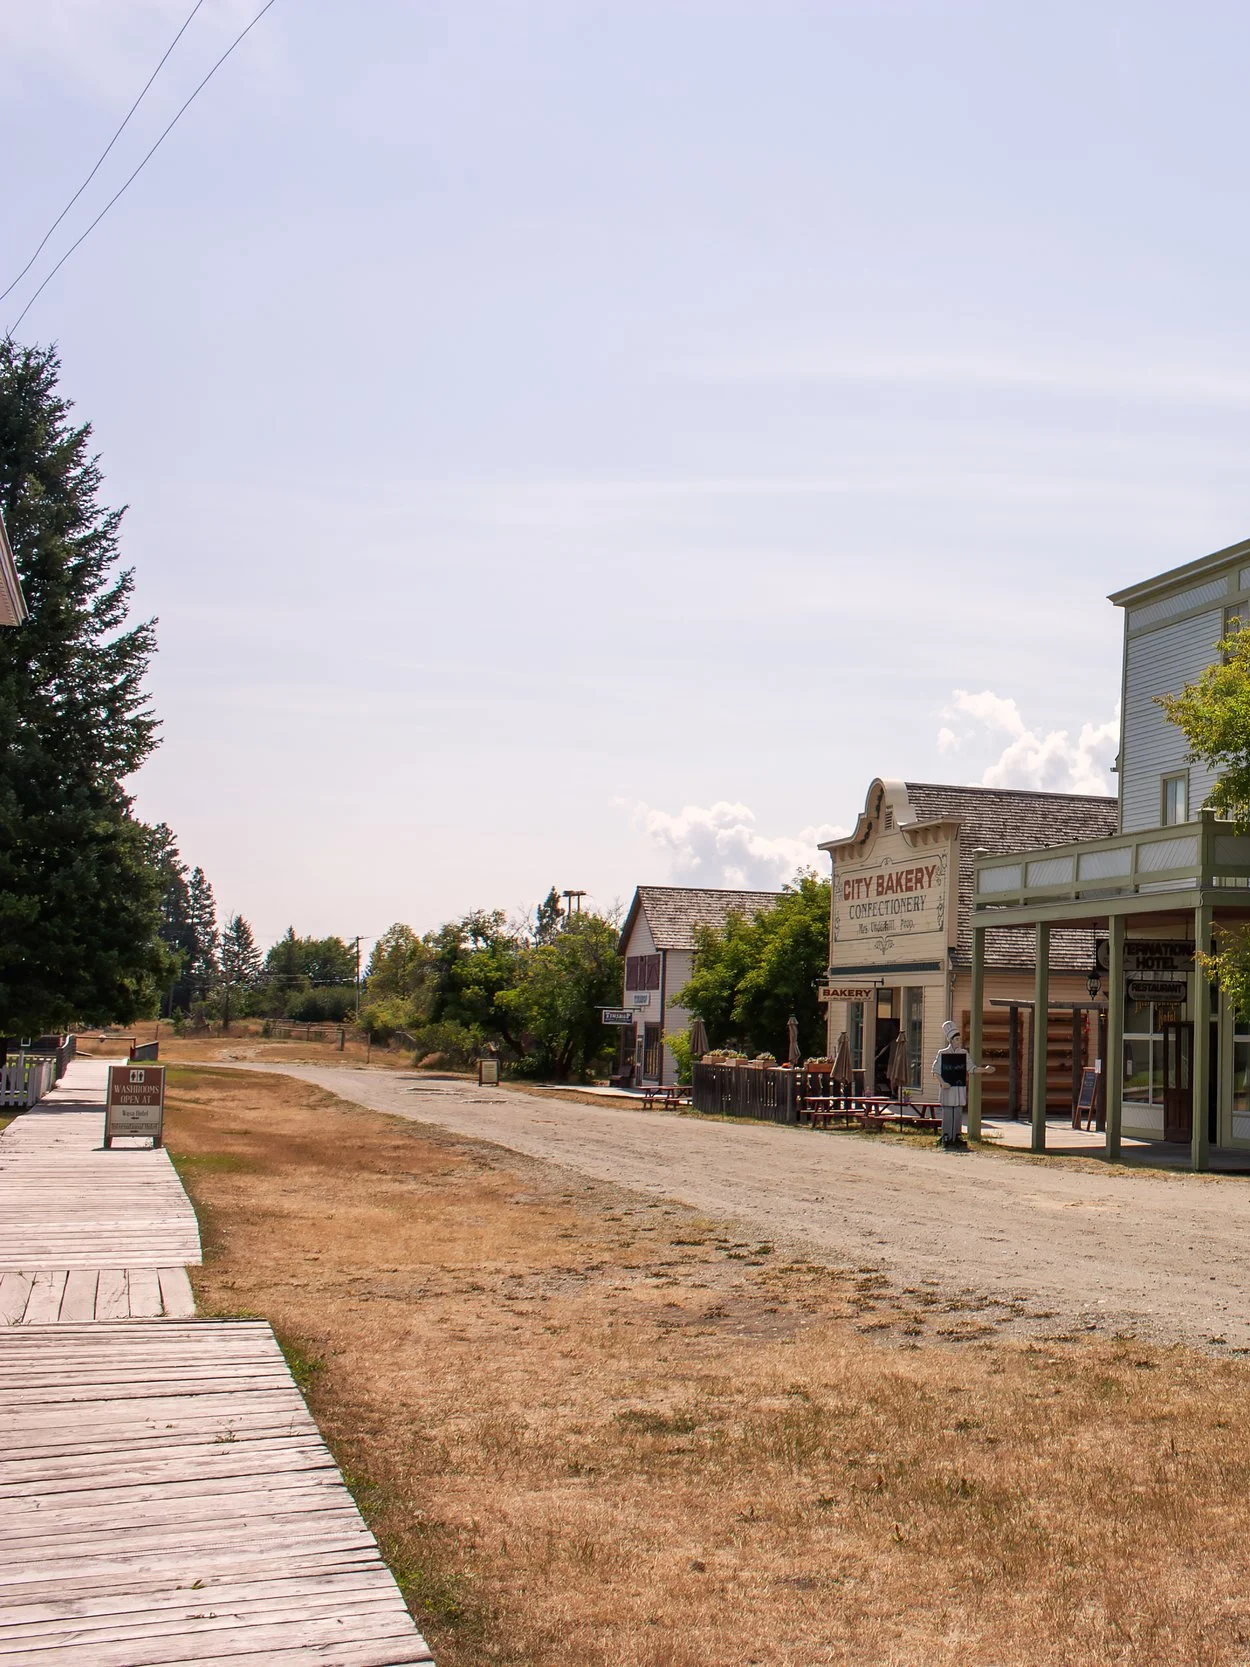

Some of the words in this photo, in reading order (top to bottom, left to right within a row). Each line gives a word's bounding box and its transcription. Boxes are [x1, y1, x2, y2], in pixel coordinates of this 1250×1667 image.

[843, 876, 873, 901] CITY
[876, 864, 937, 896] BAKERY
[849, 895, 927, 920] CONFECTIONERY
[1136, 956, 1179, 969] HOTEL
[823, 989, 872, 997] BAKERY
[1132, 982, 1181, 993] RESTAURANT
[114, 1084, 160, 1094] WASHROOMS
[120, 1095, 140, 1104] OPEN
[142, 1095, 152, 1104] AT
